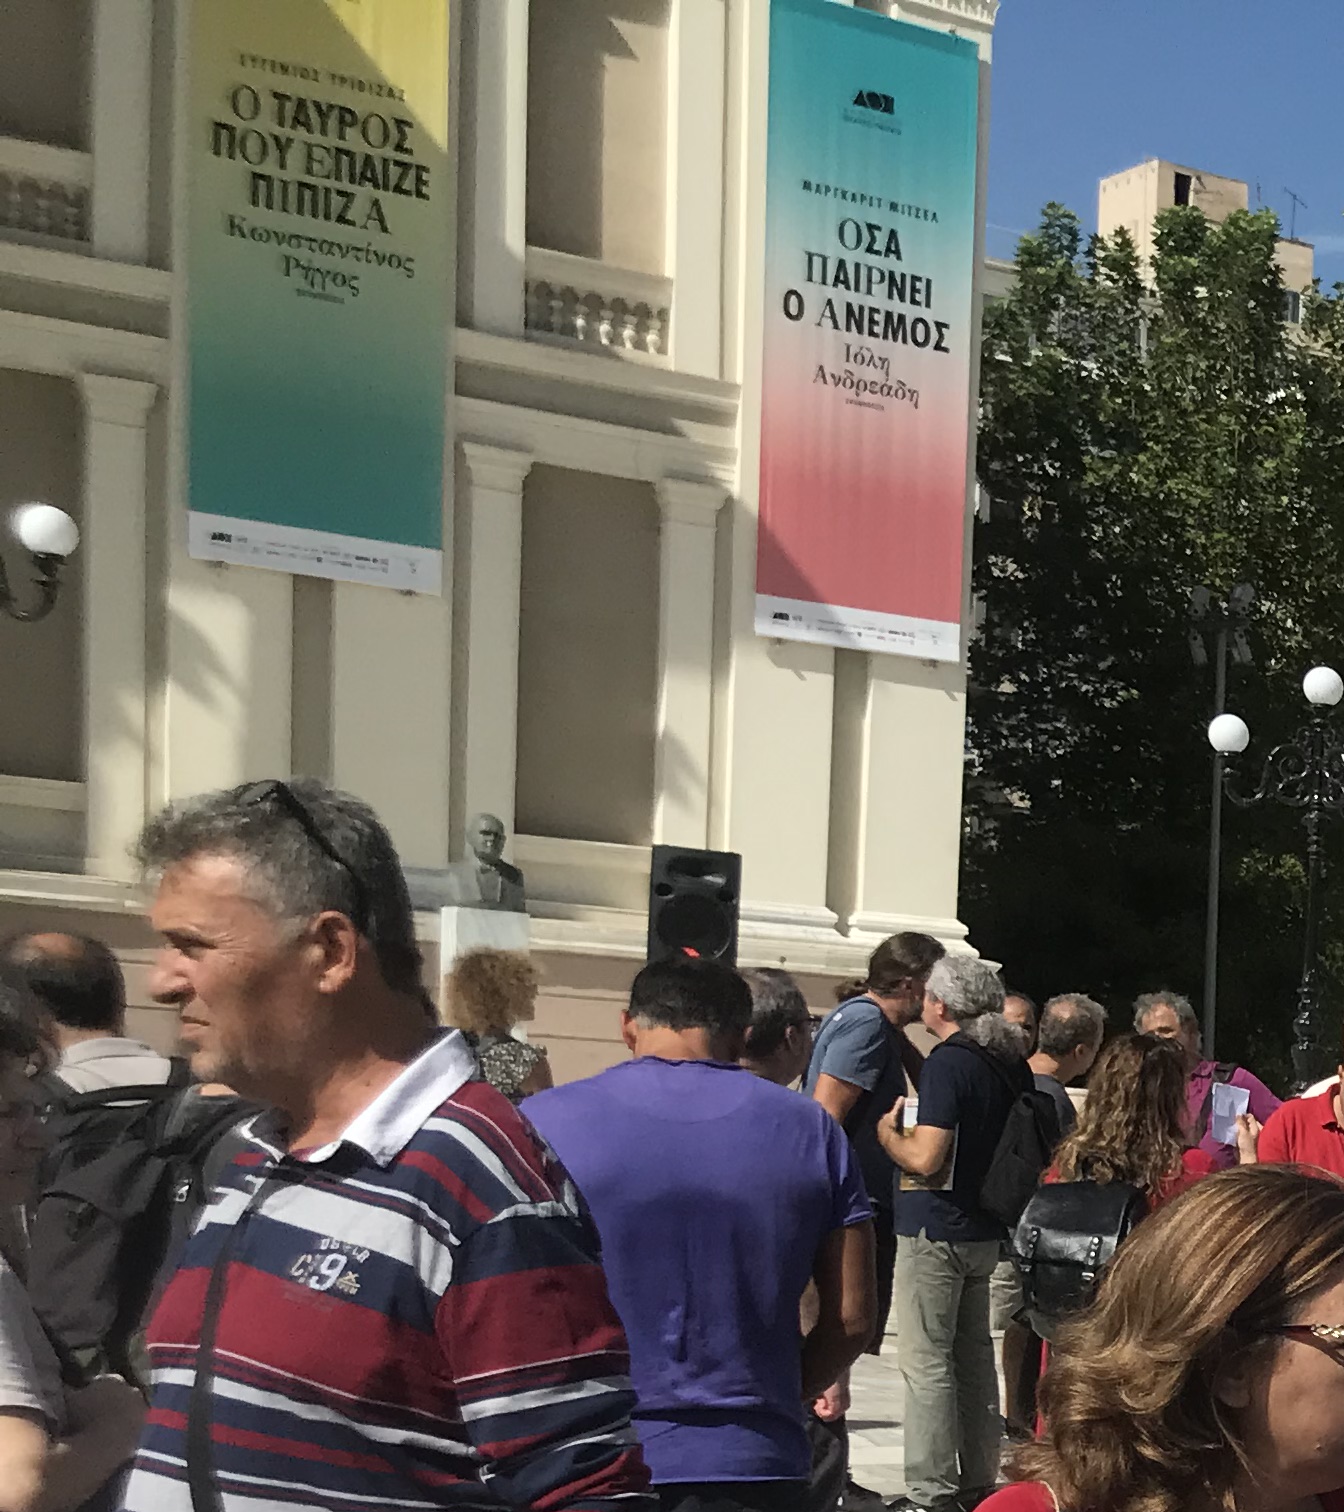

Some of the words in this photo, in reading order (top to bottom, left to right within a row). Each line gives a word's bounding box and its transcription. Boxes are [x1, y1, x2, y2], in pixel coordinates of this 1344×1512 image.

[231, 84, 262, 122] Ο
[270, 89, 414, 156] ΤΑΥΡΟΣ
[211, 120, 295, 171] ΠΟΥ
[303, 142, 431, 201] ΕΠΑΙΖΕ
[227, 213, 415, 278] Κωνσταντίνος
[838, 217, 903, 262] ΟΣΑ
[282, 254, 360, 297] Ρήγος
[804, 251, 933, 309] ΠΑΙΡΝΕΙ
[783, 289, 805, 322] Ο
[814, 298, 950, 354] ΑΝΕΜΟΣ
[813, 364, 920, 410] Ανδρεάδη
